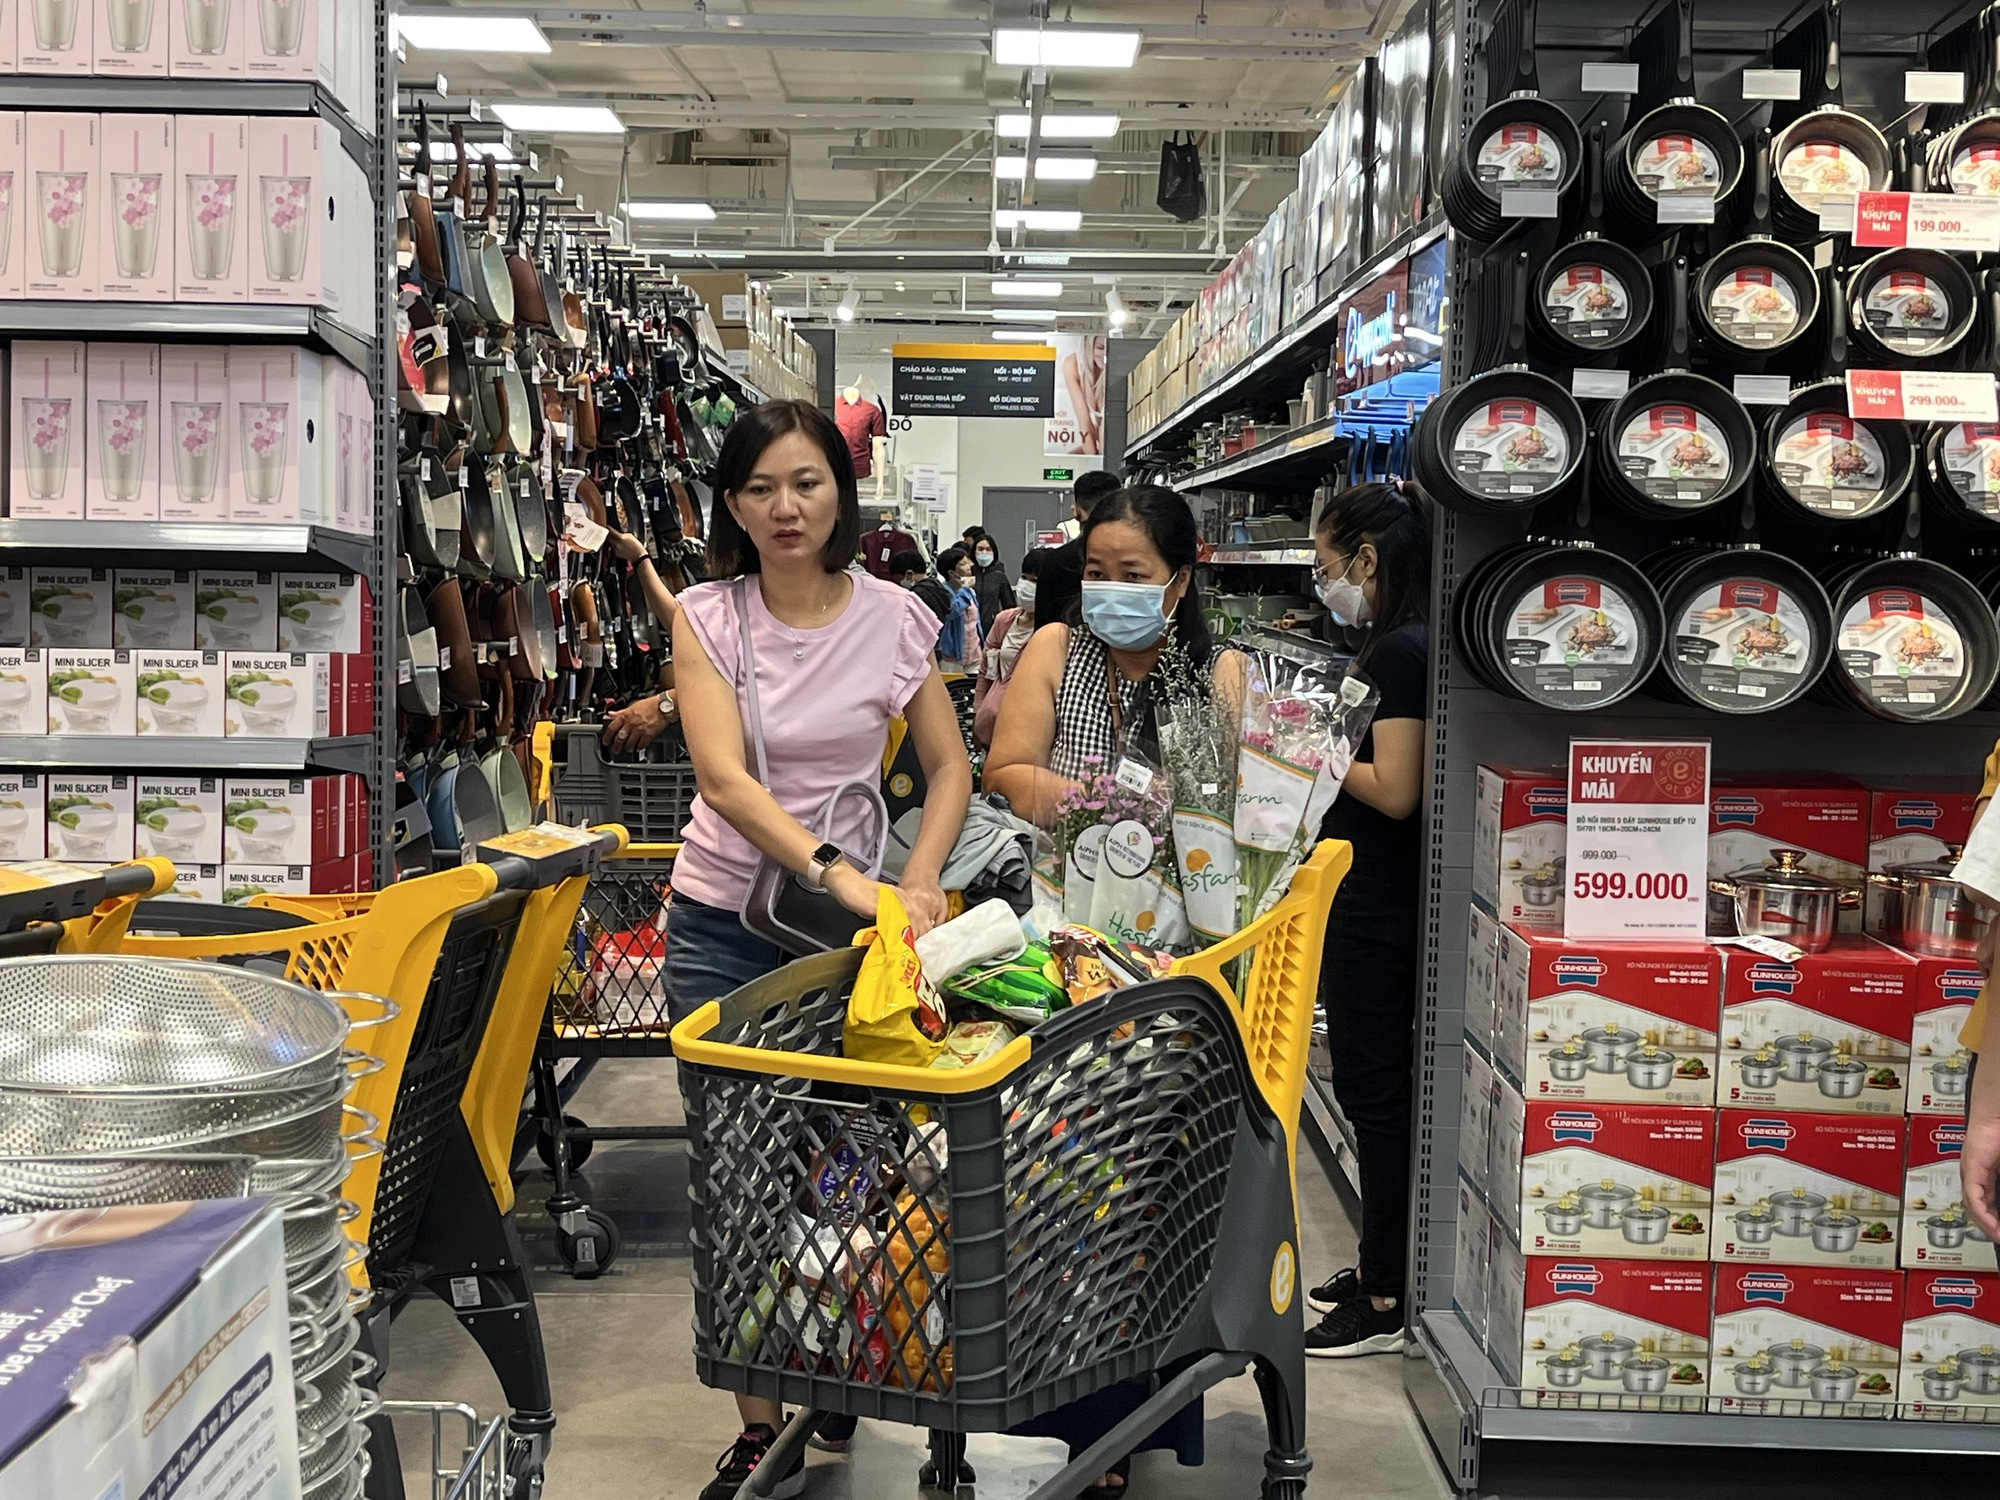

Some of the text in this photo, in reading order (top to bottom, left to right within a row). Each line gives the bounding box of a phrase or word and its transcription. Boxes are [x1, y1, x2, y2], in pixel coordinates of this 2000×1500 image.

[1912, 220, 1961, 233] 199.000
[1909, 395, 1958, 406] 299.000
[37, 576, 88, 584] MINI SLICER
[120, 577, 171, 586] MINI SLICER
[202, 578, 254, 588] MINI SLICER
[285, 581, 336, 590] MINI SLICER
[55, 657, 111, 667] MINI SLICER
[143, 658, 199, 669] MINI SLICER
[232, 660, 287, 669] MINI SLICER
[1582, 751, 1652, 773] KHUYẾN
[54, 783, 108, 793] MINI SLICER
[142, 786, 197, 796] MINI SLICER
[230, 787, 286, 797] MINI SLICER
[1581, 779, 1615, 799] MÃI
[1582, 850, 1617, 860] 999.000
[229, 874, 284, 884] MINI SLICER
[1574, 872, 1688, 899] 599.000
[1513, 906, 1522, 916] 5
[1555, 965, 1602, 973] SUNHOUSE
[1751, 972, 1797, 980] SUNHOUSE
[1540, 1081, 1549, 1092] 5
[1730, 1088, 1740, 1099] 5
[1922, 1095, 1931, 1106] 5
[1551, 1120, 1597, 1128] SUNHOUSE
[1744, 1128, 1790, 1136] SUNHOUSE
[1935, 1133, 1965, 1141] SUNHO
[1535, 1236, 1545, 1247] 5
[1725, 1243, 1734, 1254] 5
[1917, 1248, 1926, 1259] 5
[1552, 1273, 1598, 1281] SUNHOUSE
[1743, 1281, 1788, 1289] SUNHOUSE
[1932, 1286, 1977, 1294] SUNHOUSE
[25, 1306, 93, 1343] Super
[72, 1276, 134, 1305] Chef
